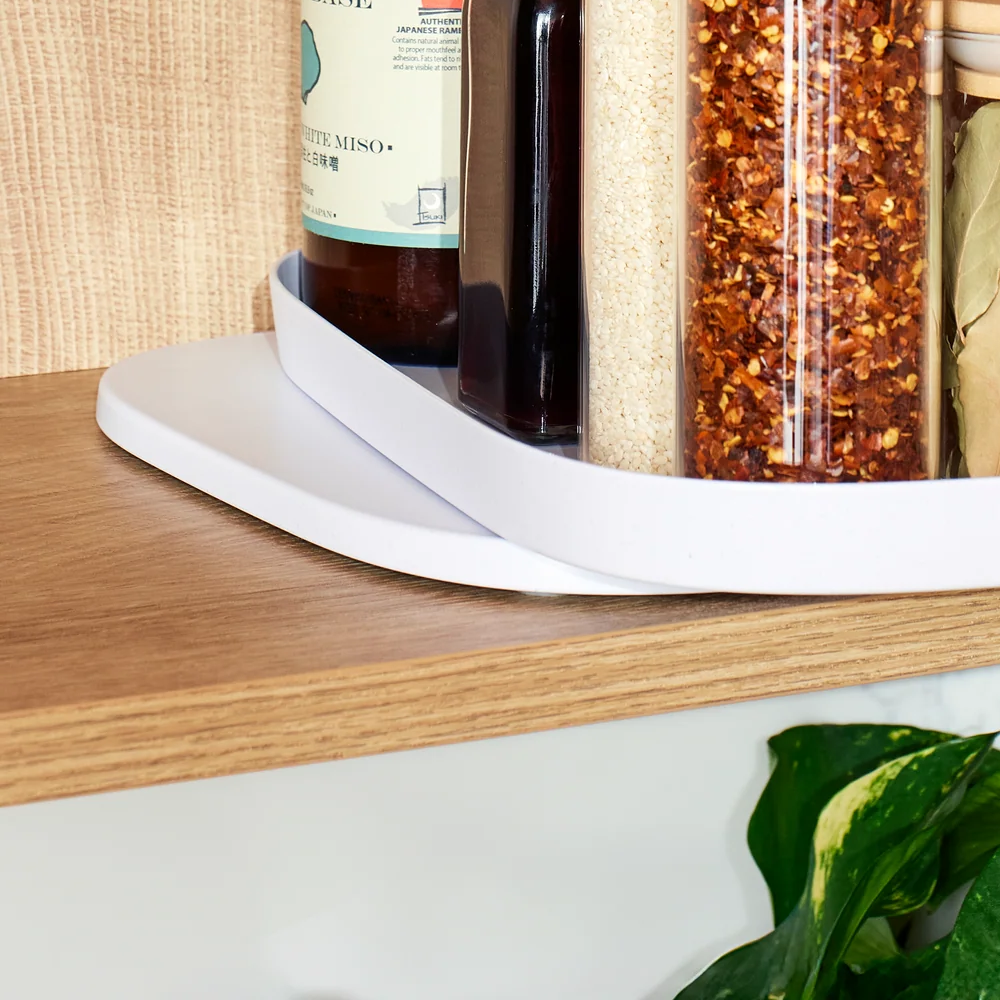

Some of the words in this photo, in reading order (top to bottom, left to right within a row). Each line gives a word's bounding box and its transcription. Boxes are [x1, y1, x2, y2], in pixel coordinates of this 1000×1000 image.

[396, 26, 437, 34] JAPANESE
[391, 36, 417, 44] Contains
[418, 37, 438, 45] natural
[439, 37, 459, 45] animal
[335, 134, 384, 154] MISO
